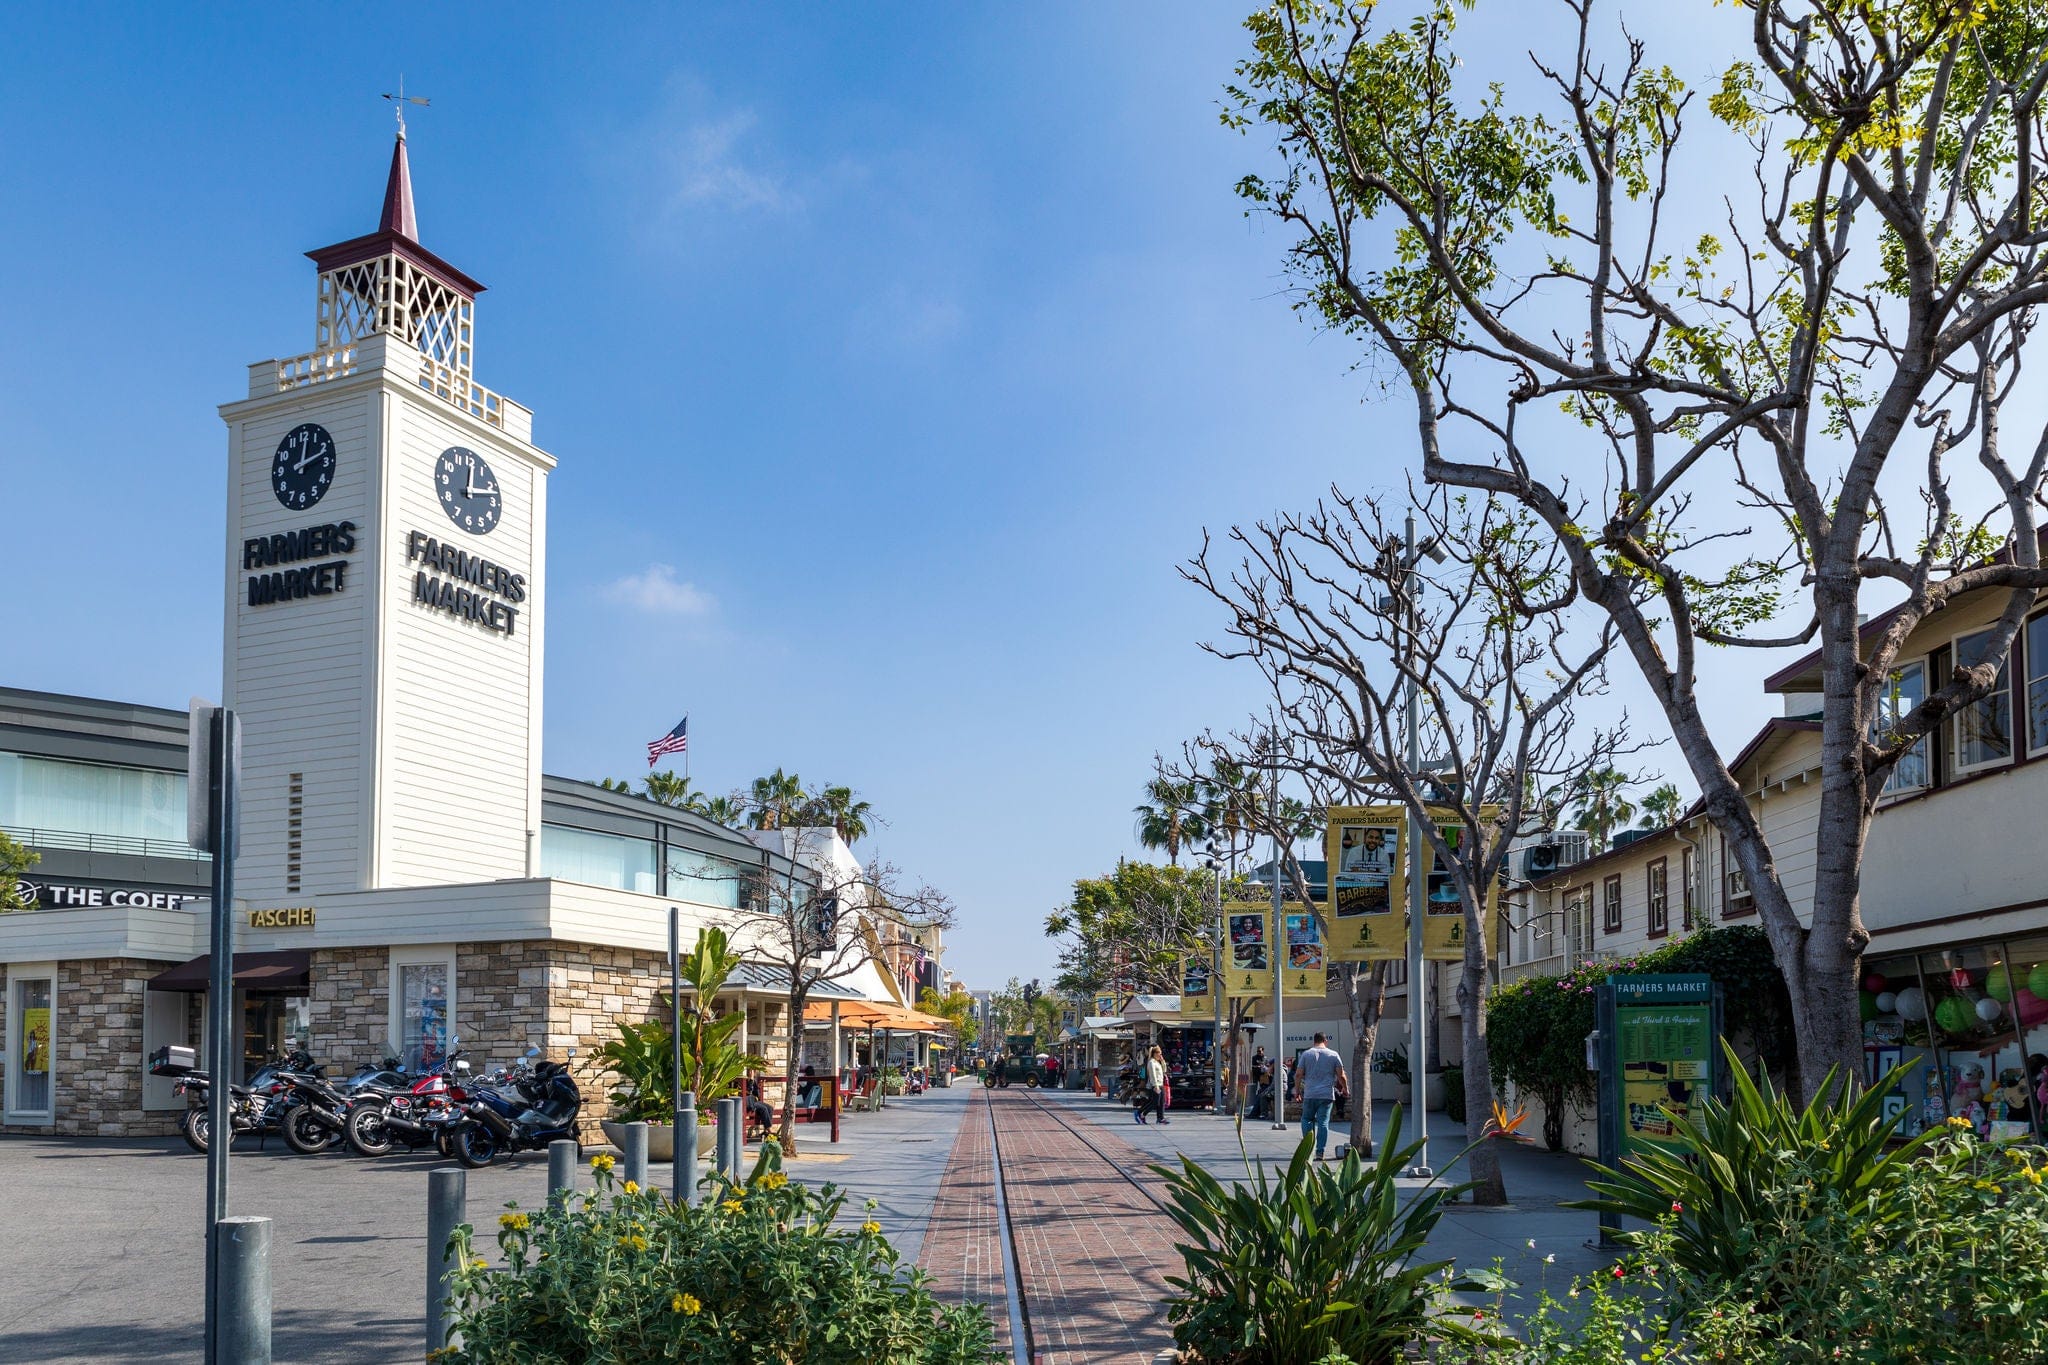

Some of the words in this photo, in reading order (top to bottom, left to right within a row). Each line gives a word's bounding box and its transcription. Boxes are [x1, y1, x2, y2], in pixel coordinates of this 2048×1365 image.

[300, 431, 309, 442] 12
[313, 432, 317, 443] 1
[290, 437, 296, 448] 11
[320, 442, 327, 452] 2
[280, 450, 289, 461] 10
[455, 454, 462, 466] 11
[465, 455, 475, 467] 12
[323, 457, 329, 467] 3
[444, 460, 454, 472] 10
[278, 466, 284, 477] 9
[480, 466, 484, 477] 1
[319, 473, 326, 484] 4
[442, 474, 449, 485] 9
[280, 481, 287, 491] 8
[311, 486, 318, 496] 5
[289, 490, 295, 501] 7
[299, 492, 306, 502] 6
[445, 491, 452, 502] 8
[490, 497, 496, 507] 3
[454, 506, 461, 516] 7
[486, 511, 493, 521] 4
[465, 515, 472, 526] 6
[478, 517, 485, 527] 5
[244, 520, 356, 570] FARMERS
[410, 530, 526, 603] FARMERS
[248, 560, 348, 606] MARKET
[416, 571, 520, 636] MARKET
[1332, 817, 1366, 825] FARMERS
[50, 886, 103, 907] THE
[110, 891, 212, 910] COFF
[1617, 983, 1663, 993] FARMERS
[1667, 982, 1707, 992] MARKET
